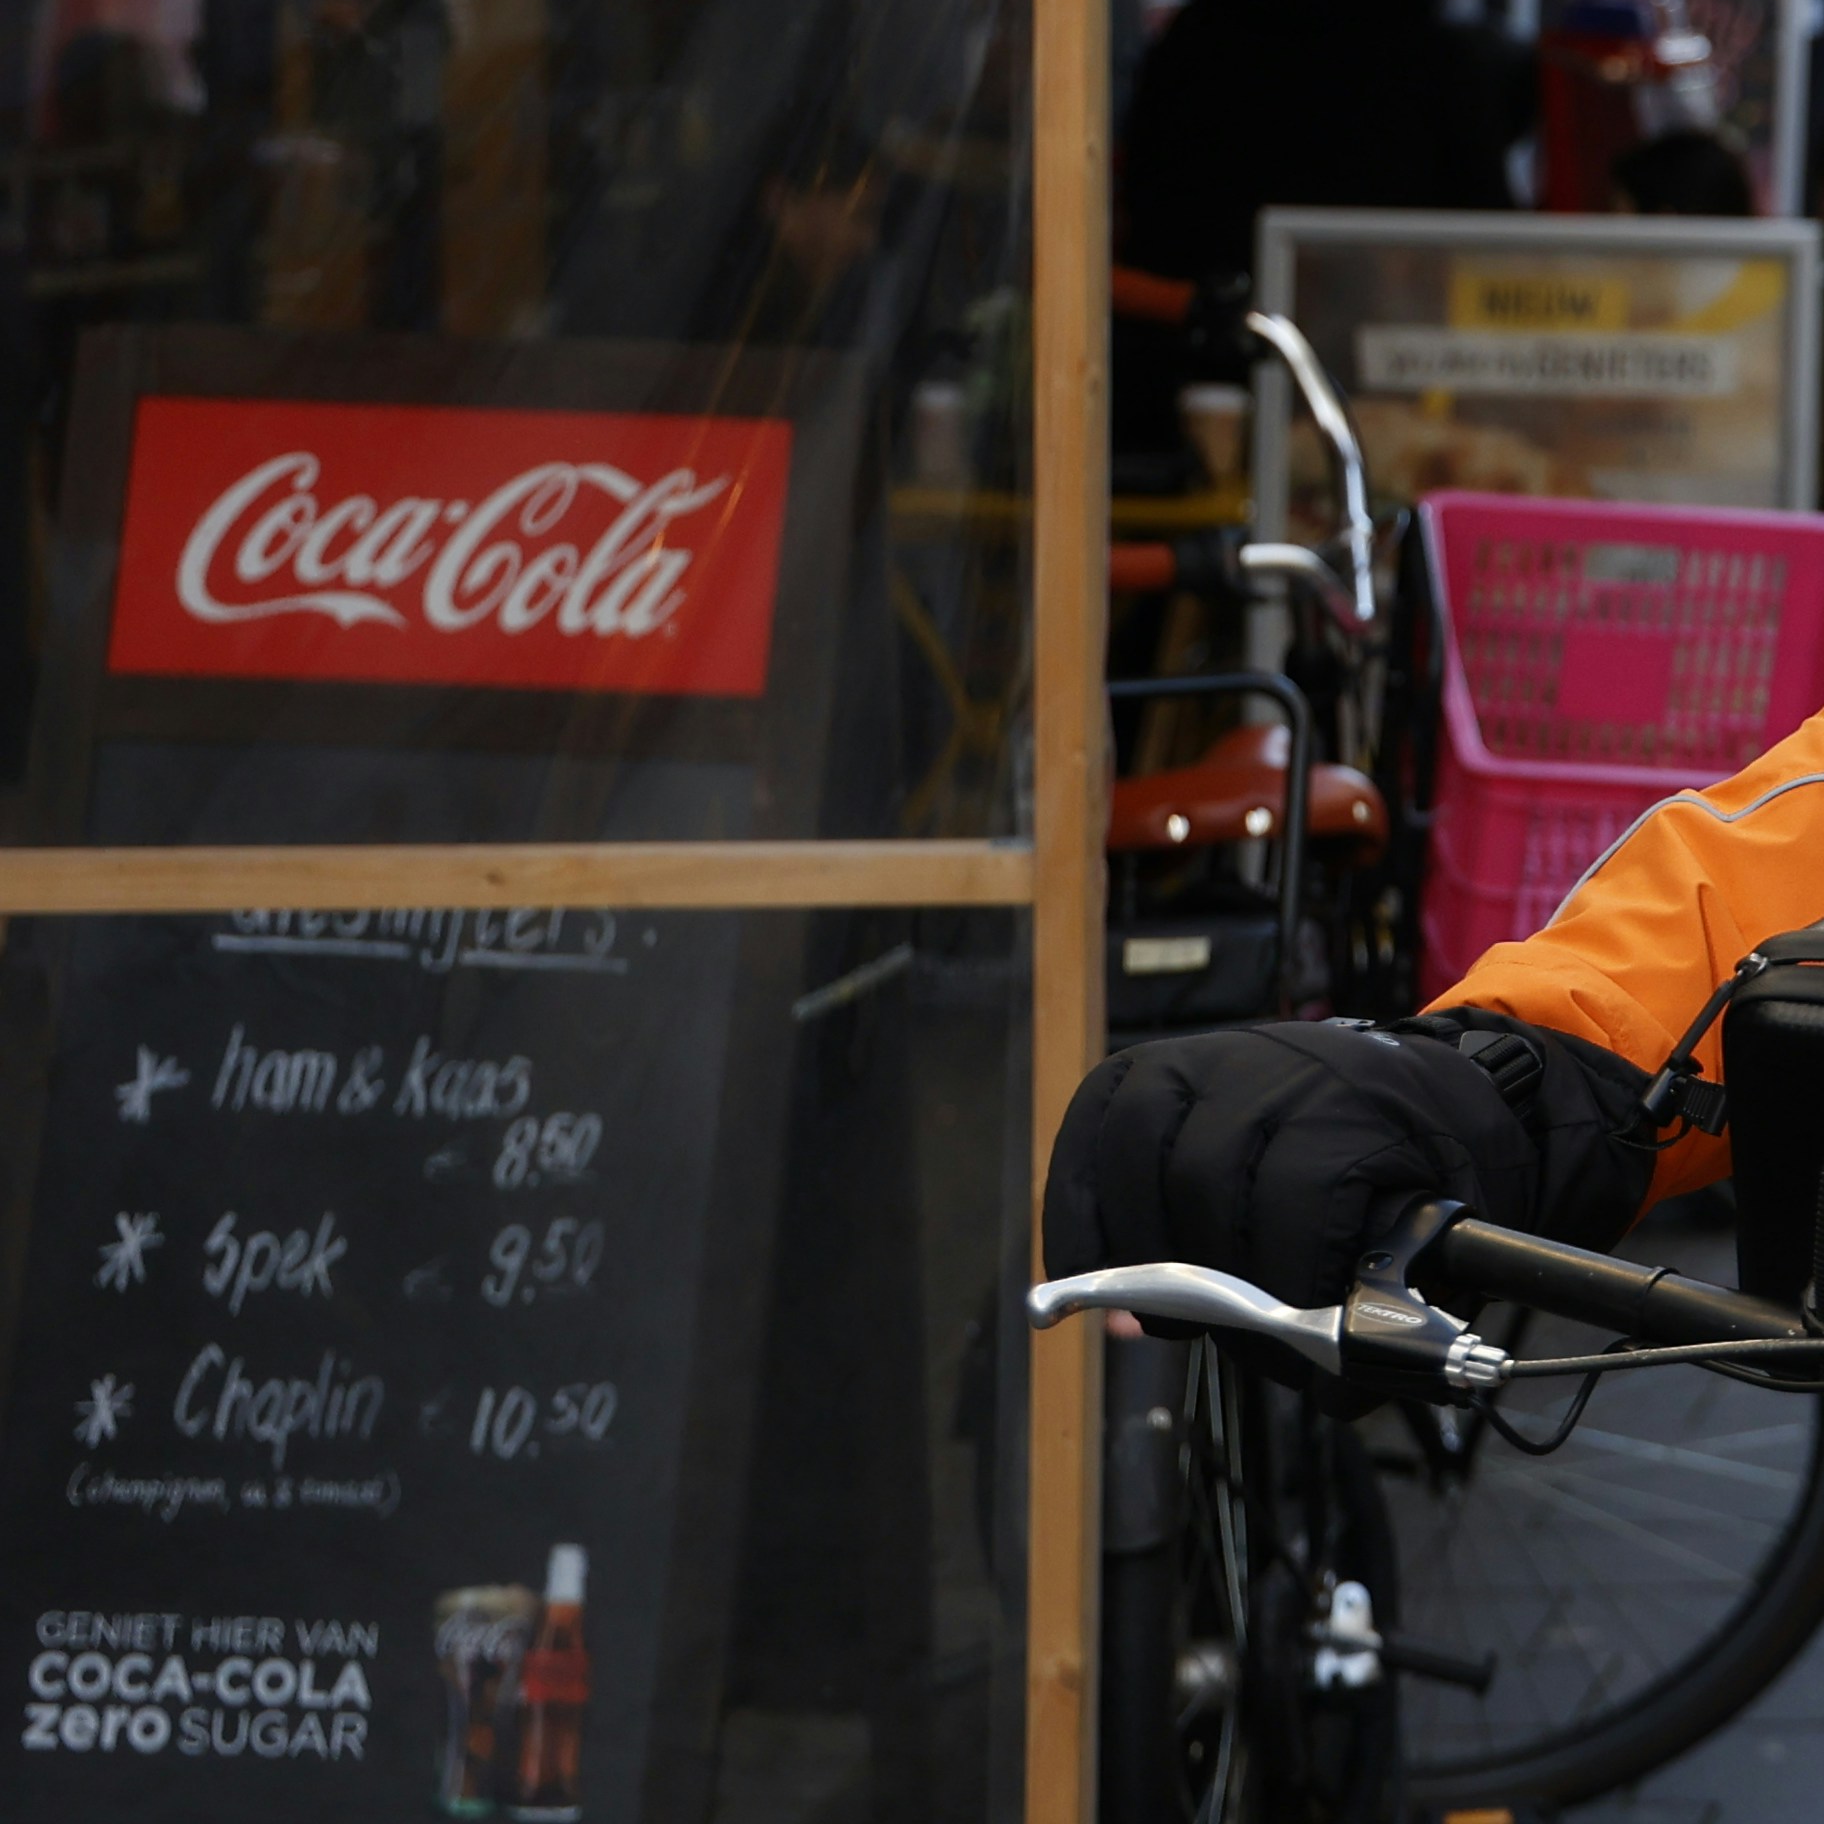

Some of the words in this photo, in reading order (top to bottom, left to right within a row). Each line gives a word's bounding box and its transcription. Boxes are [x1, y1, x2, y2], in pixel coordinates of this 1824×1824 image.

[175, 451, 732, 636] Coca-Cola
[211, 1022, 337, 1113] ham
[480, 1216, 604, 1308] 9.50
[1357, 1304, 1423, 1325] TEKTRO
[172, 1341, 386, 1471] Chaplin
[470, 1379, 619, 1461] 10.50
[36, 1610, 183, 1650] GENIET
[191, 1616, 286, 1655] HIER
[295, 1619, 380, 1659] VAN
[27, 1649, 373, 1711] COCA-COLA
[19, 1702, 173, 1755] zero
[176, 1708, 370, 1761] SUGAR
